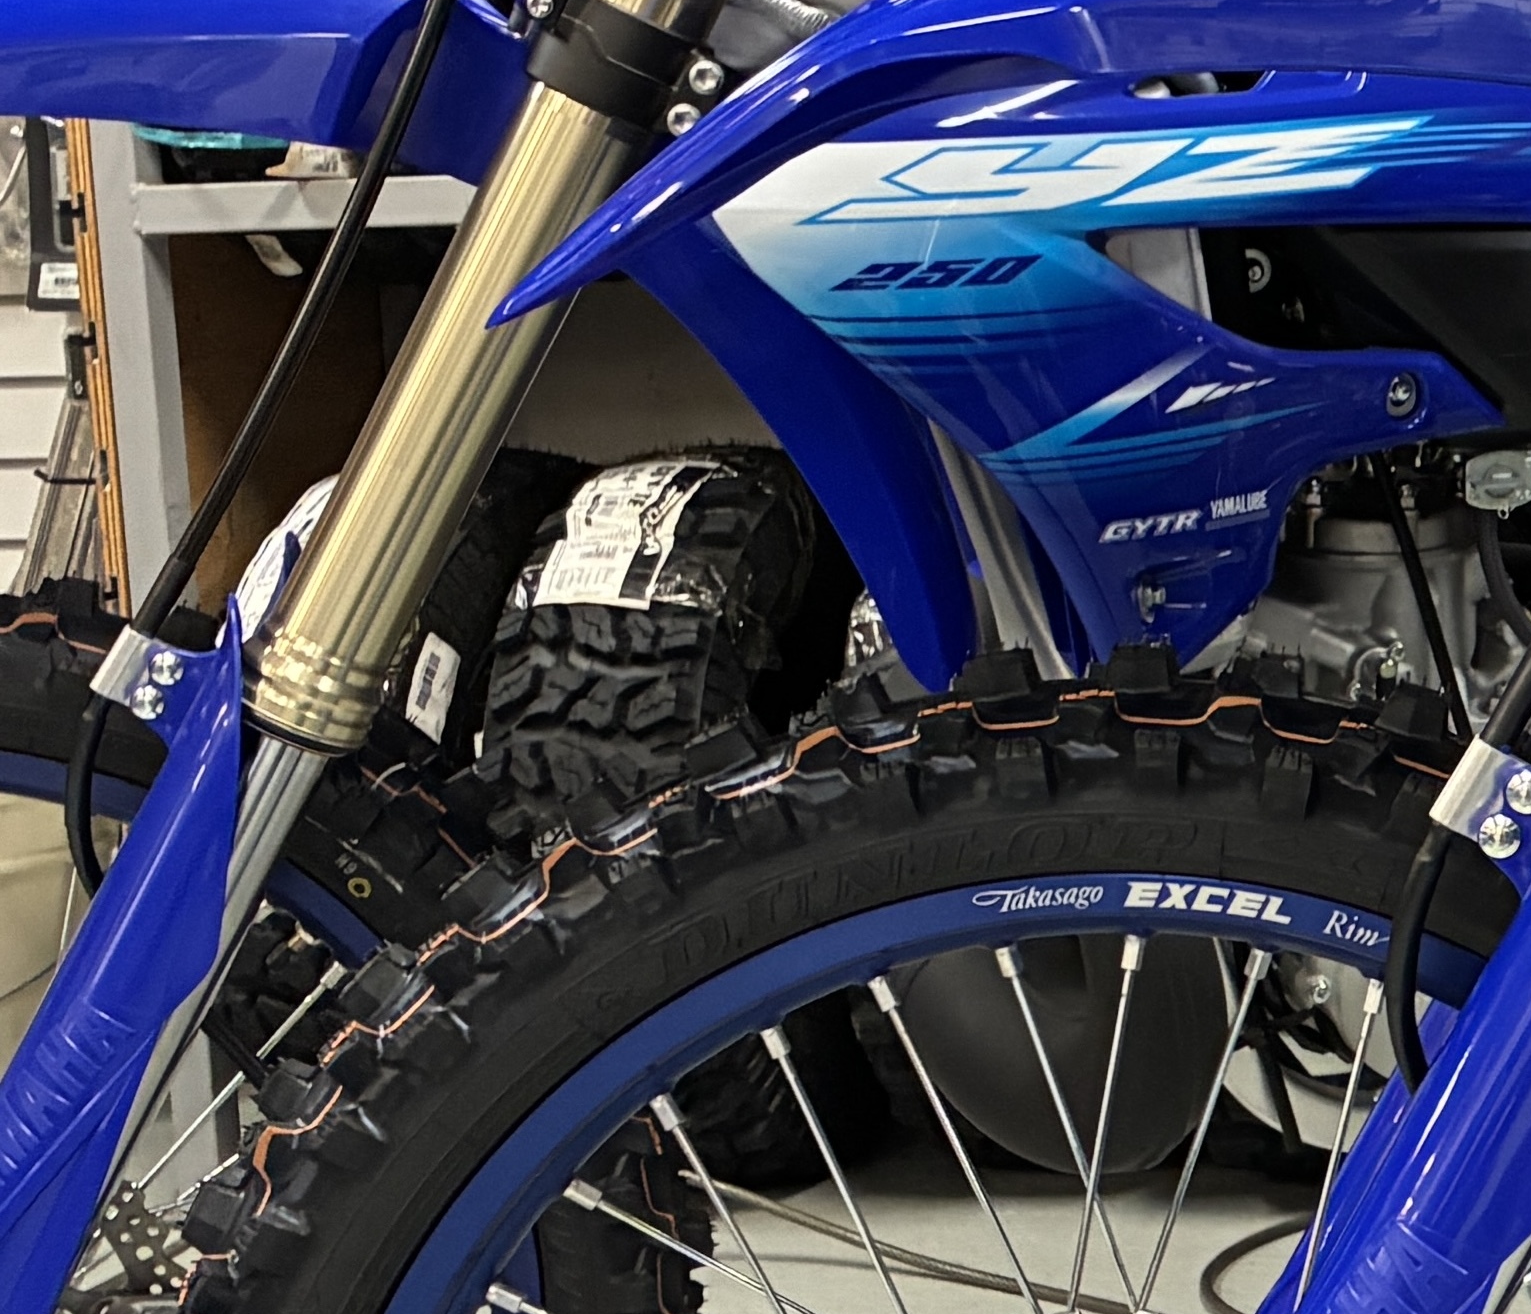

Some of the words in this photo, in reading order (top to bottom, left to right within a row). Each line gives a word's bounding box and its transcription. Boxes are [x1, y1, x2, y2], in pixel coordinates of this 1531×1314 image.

[829, 253, 1043, 292] 250
[1098, 509, 1204, 544] GYTR
[1210, 489, 1269, 519] YAMALUBE
[972, 886, 1104, 913] Takasago
[1124, 881, 1292, 925] EXCEL
[1323, 910, 1391, 947] Rim
